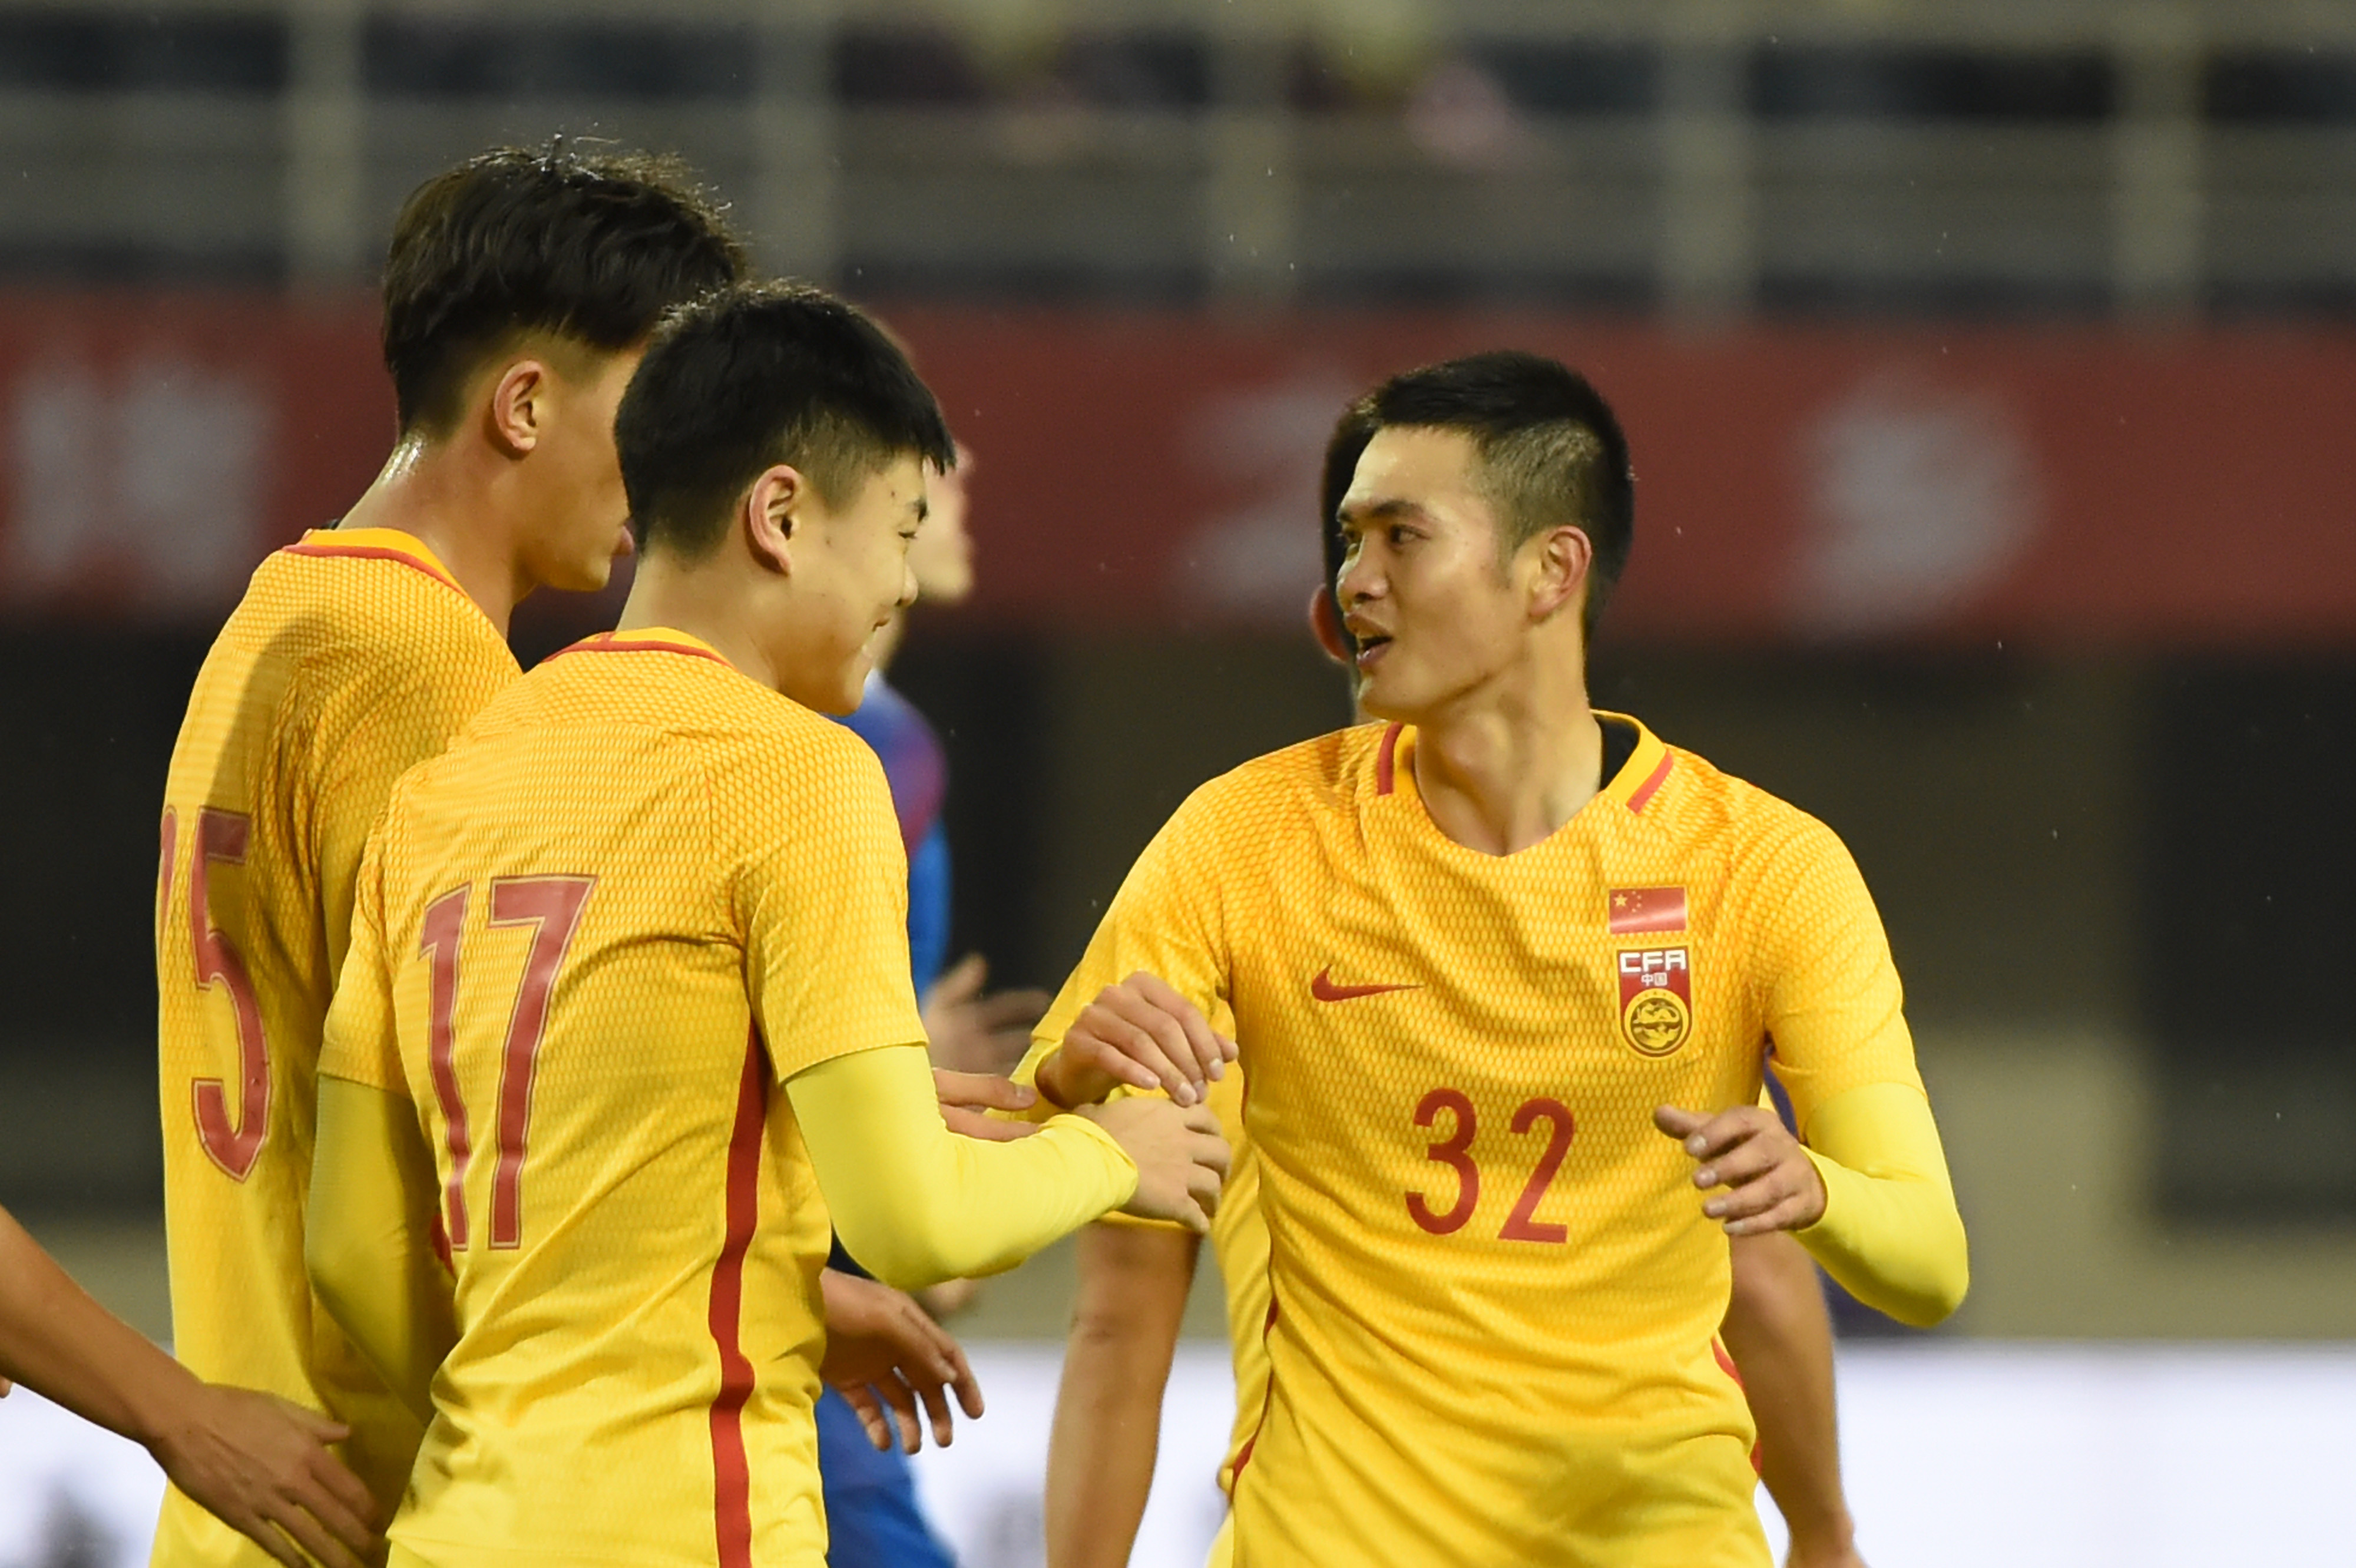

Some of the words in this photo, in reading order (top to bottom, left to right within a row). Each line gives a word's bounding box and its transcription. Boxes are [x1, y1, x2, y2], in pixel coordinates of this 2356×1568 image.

[1620, 950, 1686, 972] CFA
[418, 874, 598, 1251] 17
[1405, 1087, 1575, 1244] 32
